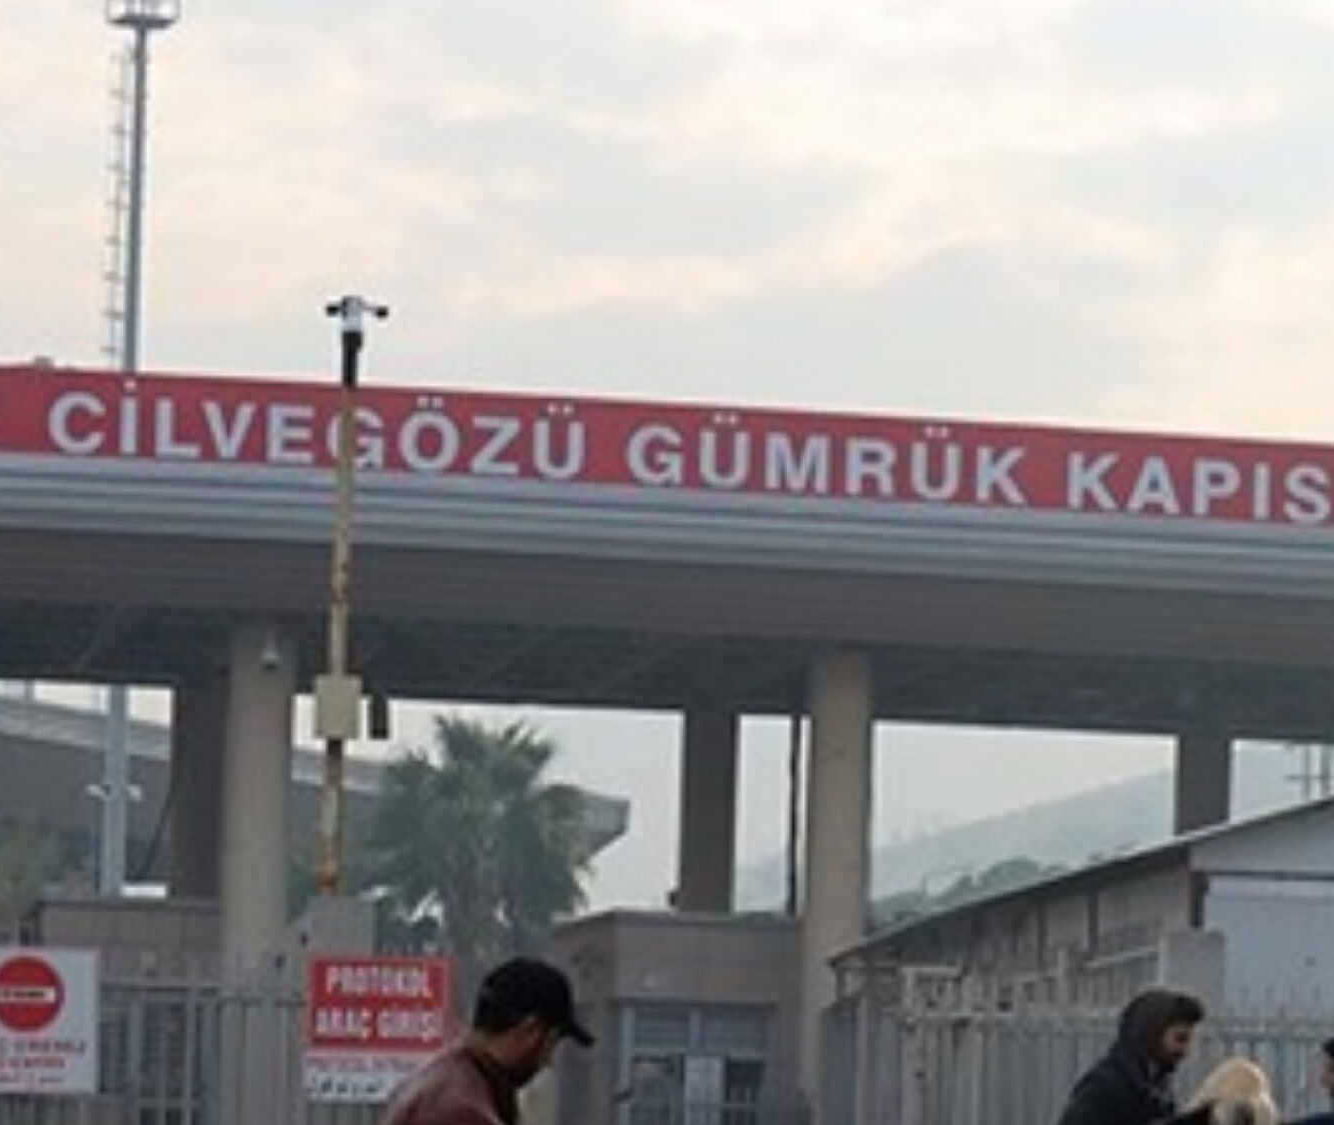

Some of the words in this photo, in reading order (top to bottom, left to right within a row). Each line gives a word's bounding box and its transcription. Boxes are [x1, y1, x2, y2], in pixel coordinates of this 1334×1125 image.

[47, 380, 586, 479] CİLVEGÖZÜ
[627, 412, 1027, 504] GÜMRÜK
[326, 965, 434, 998] PROTOKOL
[315, 1007, 372, 1040] ARAÇ
